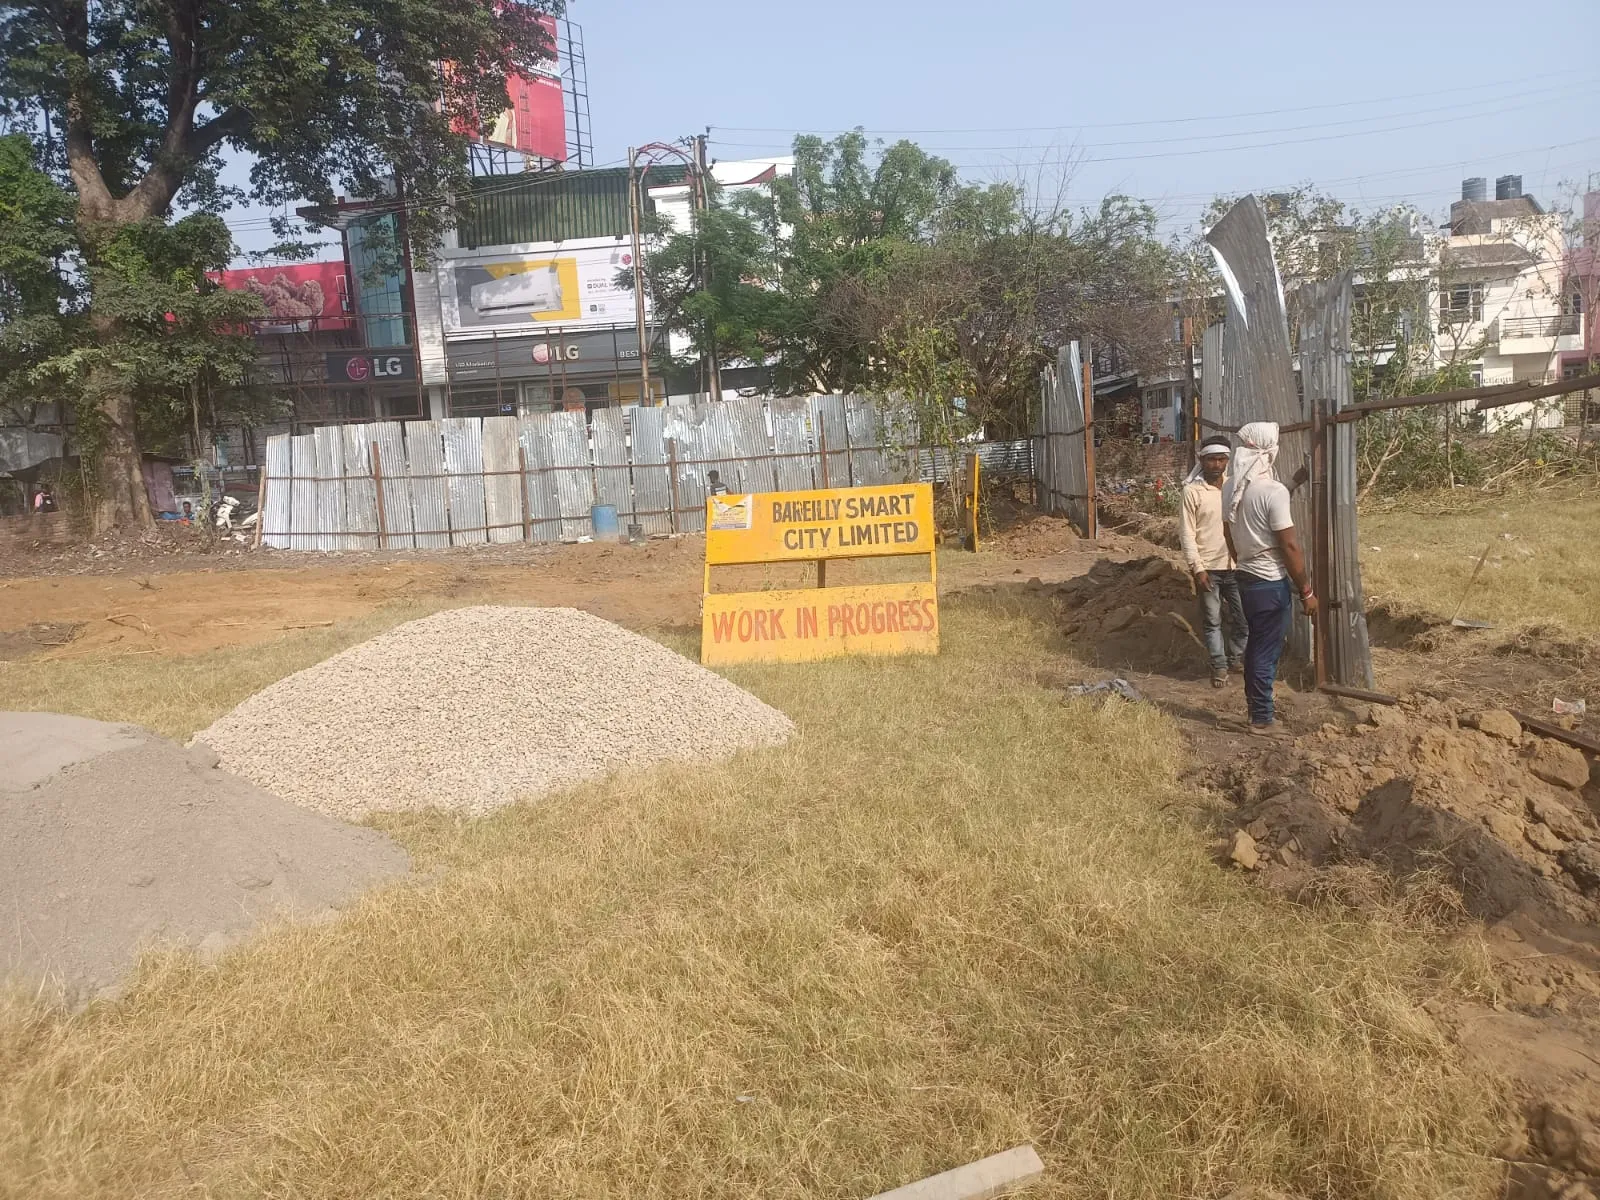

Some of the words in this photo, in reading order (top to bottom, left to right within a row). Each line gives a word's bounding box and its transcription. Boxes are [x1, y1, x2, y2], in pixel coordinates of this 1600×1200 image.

[555, 344, 579, 361] LG
[619, 350, 640, 358] BEST
[373, 357, 402, 377] LG
[501, 404, 512, 412] LG
[772, 498, 842, 524] BAREILLY
[845, 493, 915, 520] SMART
[783, 527, 832, 551] CITY
[838, 521, 919, 547] LIMITED
[711, 607, 786, 644] WORK
[796, 606, 819, 640] IN
[827, 599, 936, 638] PROGRESS
